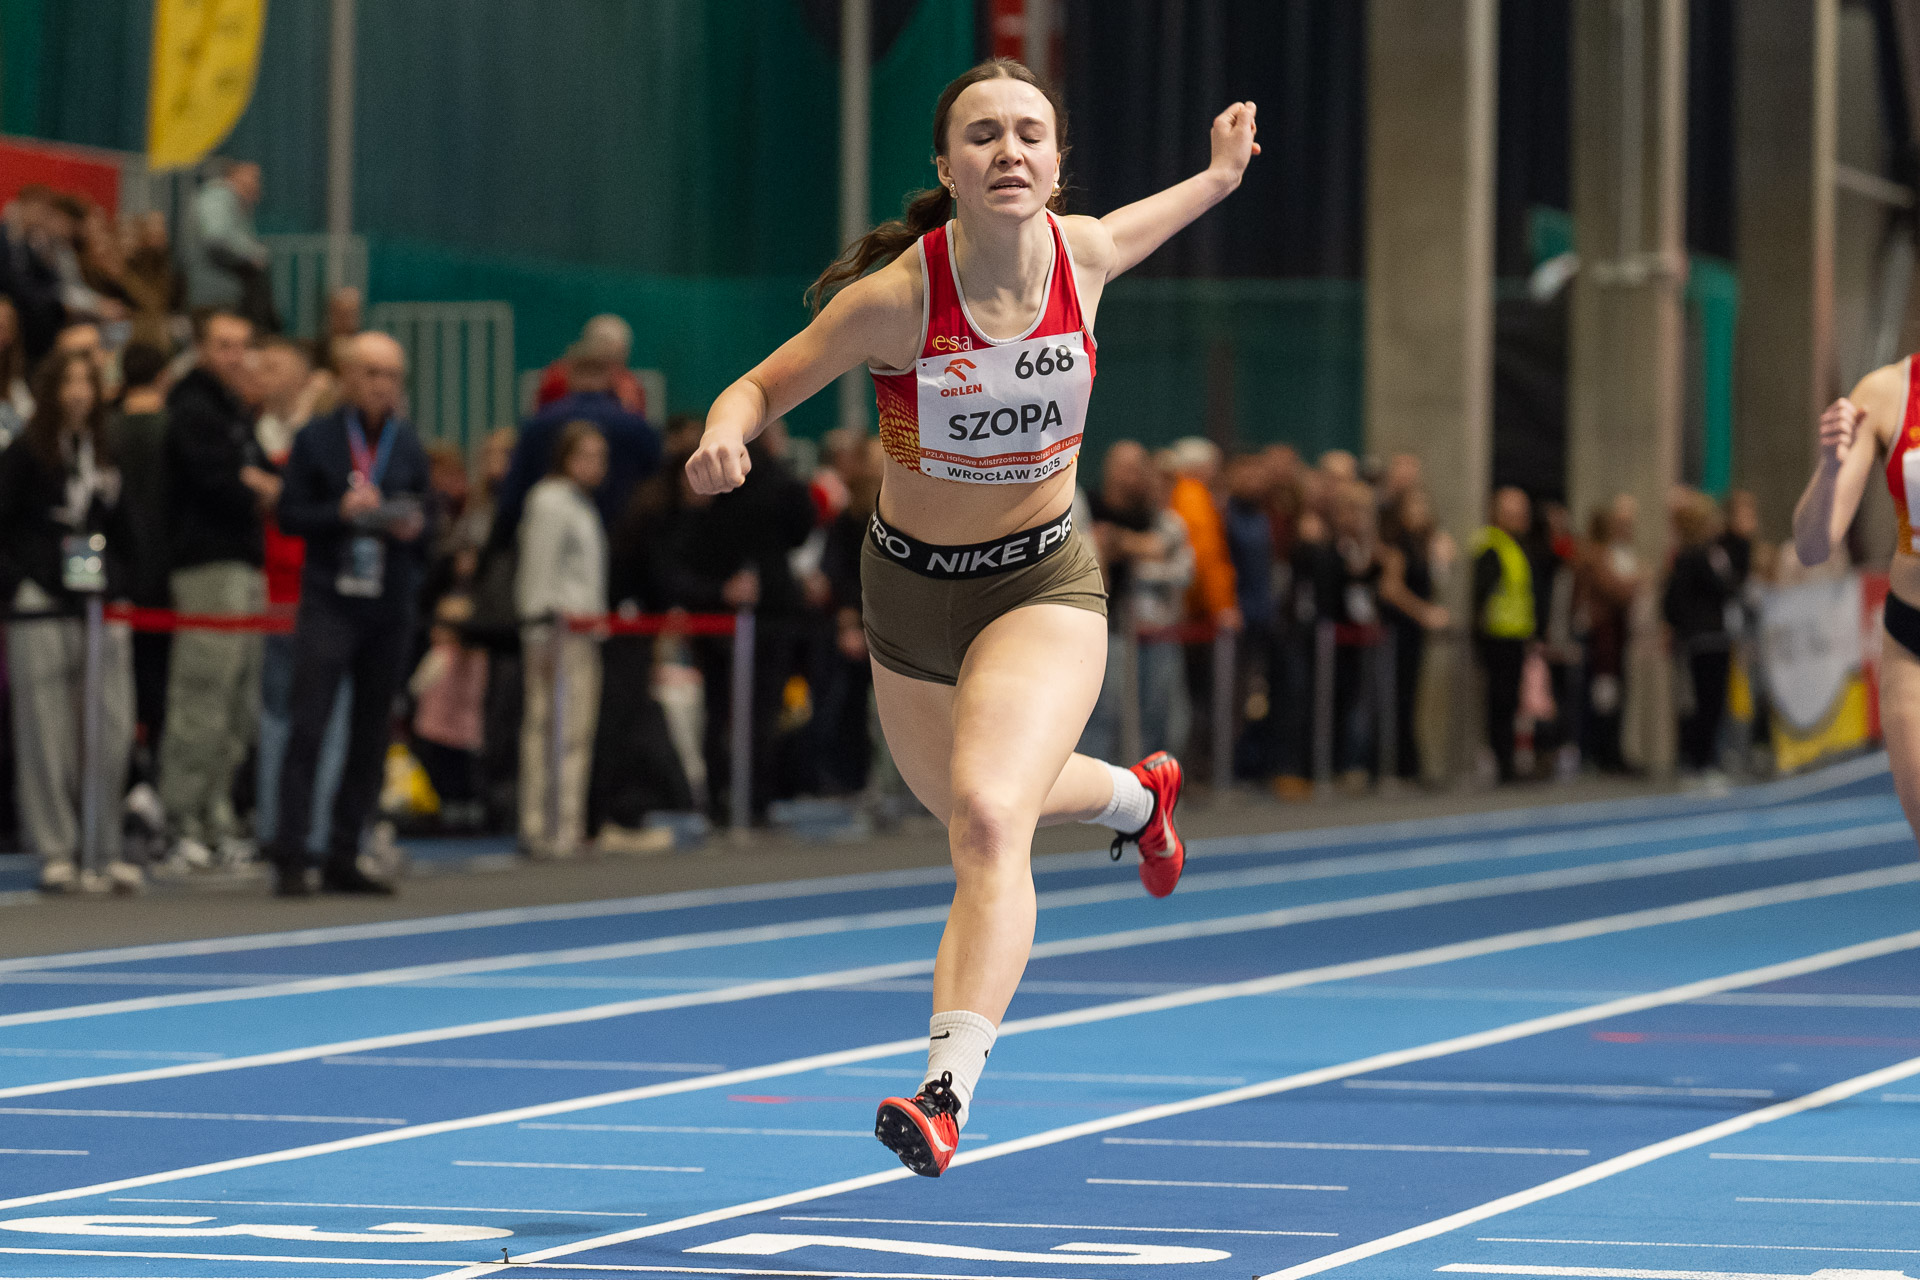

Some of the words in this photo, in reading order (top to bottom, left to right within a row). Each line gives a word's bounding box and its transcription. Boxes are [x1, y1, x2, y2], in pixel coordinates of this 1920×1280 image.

[932, 335, 973, 351] esa
[1015, 345, 1074, 379] 668
[940, 384, 983, 398] ORLEN
[949, 400, 1063, 441] SZOPA
[925, 450, 945, 460] PZLA
[946, 454, 977, 466] Halowe
[978, 455, 1029, 467] Mistrzostwa
[1030, 449, 1051, 461] Polski
[947, 466, 1031, 482] WROCŁAW
[1034, 457, 1061, 478] 2025
[926, 536, 1031, 573] NIKE
[682, 1232, 1232, 1265] 2
